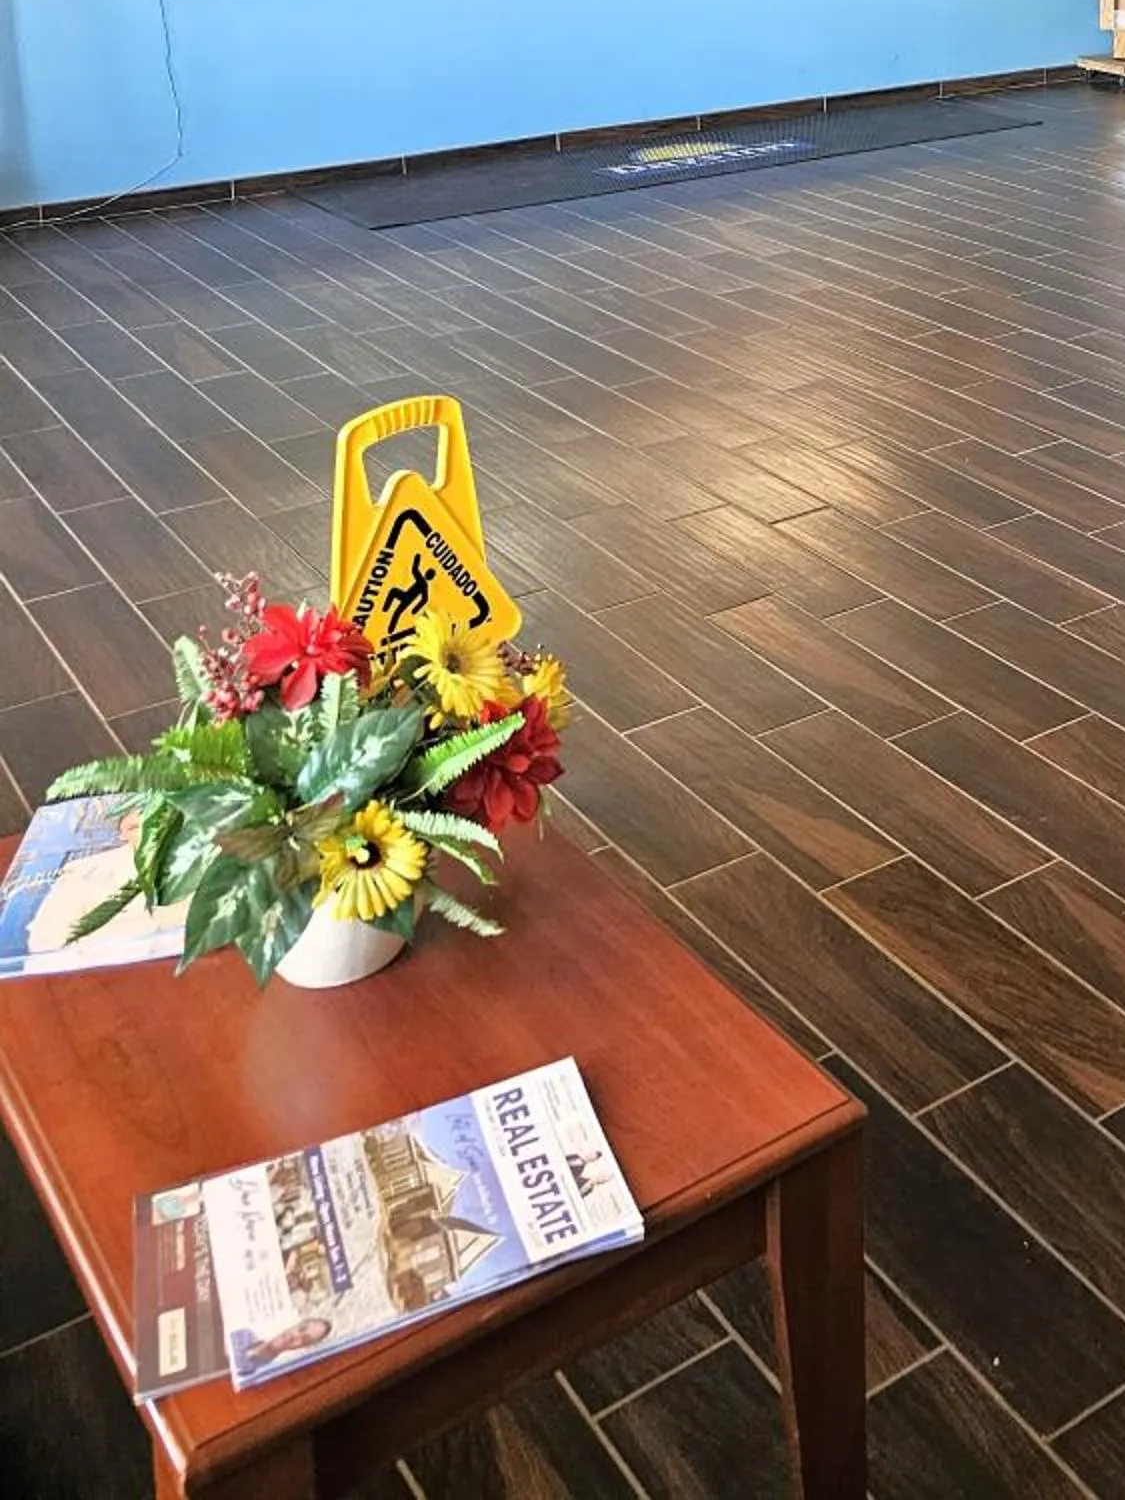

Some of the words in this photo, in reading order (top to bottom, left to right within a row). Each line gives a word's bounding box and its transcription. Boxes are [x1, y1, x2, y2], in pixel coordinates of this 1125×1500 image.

[352, 547, 394, 631] AUTION
[426, 532, 477, 596] CUIDADO
[493, 1087, 540, 1157] REAL
[516, 1153, 579, 1244] ESTATE
